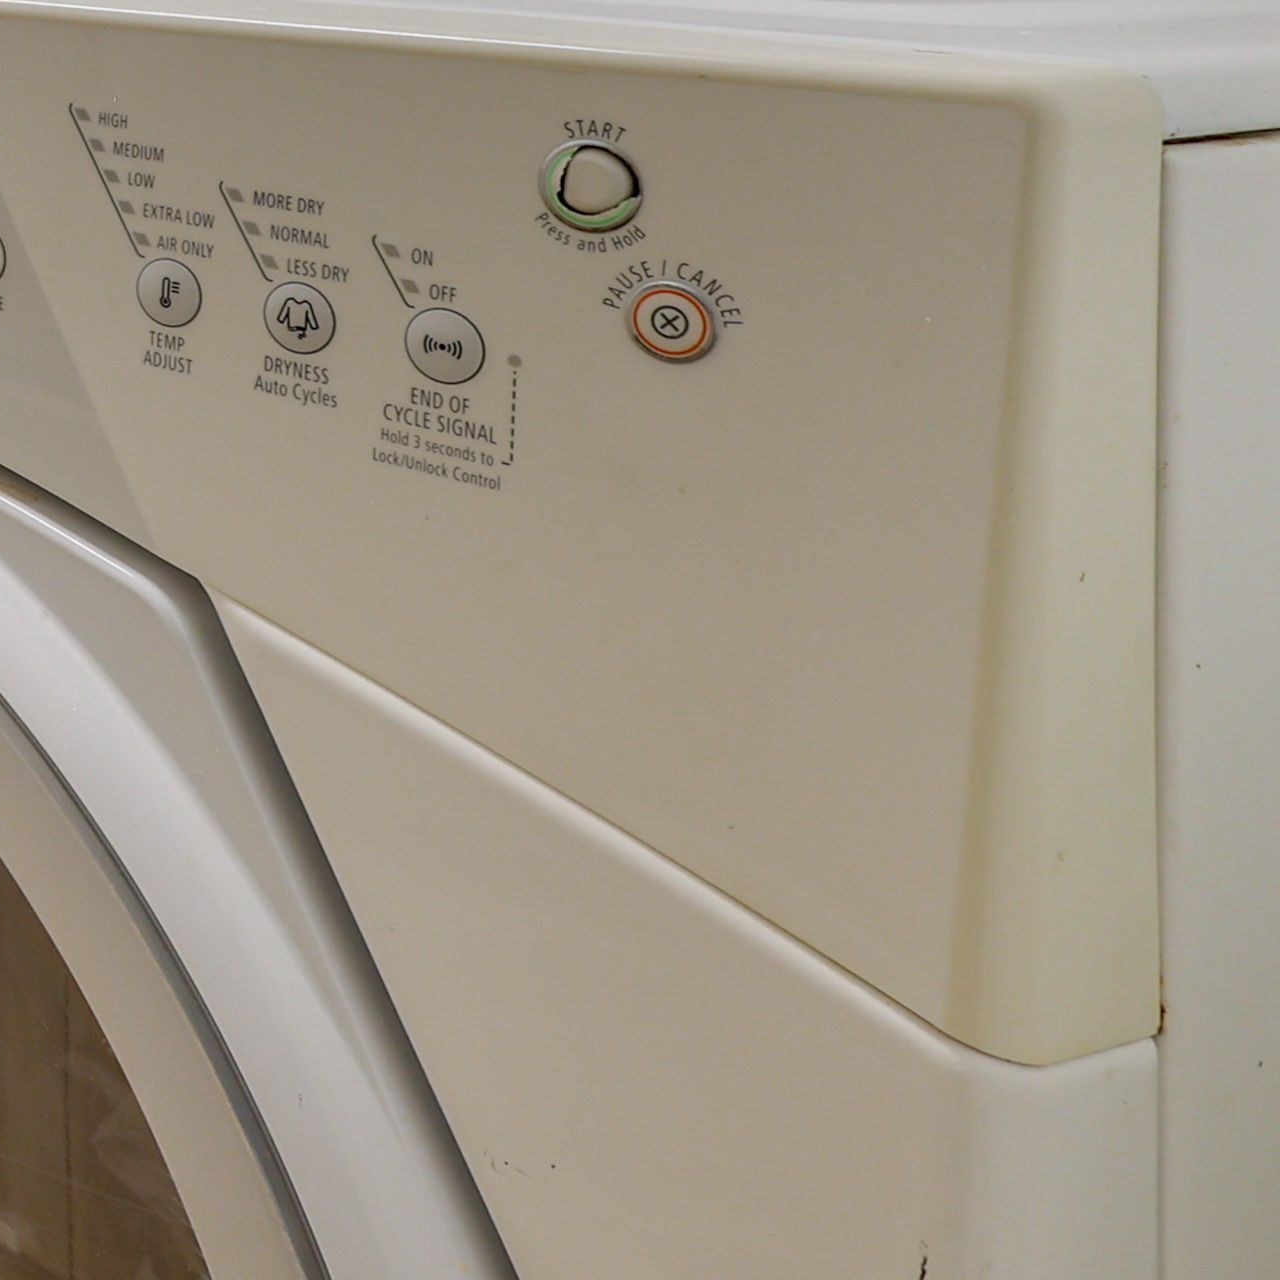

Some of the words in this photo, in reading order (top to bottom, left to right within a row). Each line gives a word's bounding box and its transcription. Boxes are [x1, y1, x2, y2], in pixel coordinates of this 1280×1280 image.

[98, 112, 128, 128] HIGH
[564, 119, 627, 143] START
[113, 141, 165, 161] MEDIUM
[128, 172, 156, 189] LOW
[253, 190, 293, 211] MORE
[297, 198, 325, 215] DRY
[143, 203, 182, 223] EXTRA
[186, 211, 215, 229] LOW
[270, 224, 330, 249] NORMAL
[534, 212, 571, 246] Press
[577, 238, 607, 253] and
[611, 225, 646, 251] Hold
[157, 236, 177, 252] AIR
[181, 239, 215, 259] ONLY
[411, 248, 433, 266] ON
[287, 258, 317, 278] LESS
[322, 265, 349, 283] DRY
[429, 284, 457, 302] OFF
[602, 261, 654, 309] PAUSE
[677, 262, 744, 328] CANCEL
[149, 330, 185, 352] TEMP
[143, 350, 192, 375] ADJUST
[264, 355, 330, 385] DRYNESS
[254, 375, 287, 397] Auto
[292, 383, 338, 408] Cycles
[411, 387, 443, 409] END
[449, 395, 470, 415] OF
[383, 403, 431, 430] CYCLE
[437, 415, 497, 445] SIGNAL
[381, 427, 409, 446] Hold
[413, 434, 420, 449] 3
[425, 438, 476, 462] seconds
[480, 452, 494, 466] to
[372, 447, 448, 478] Lock/Unlock
[452, 466, 501, 490] Control
